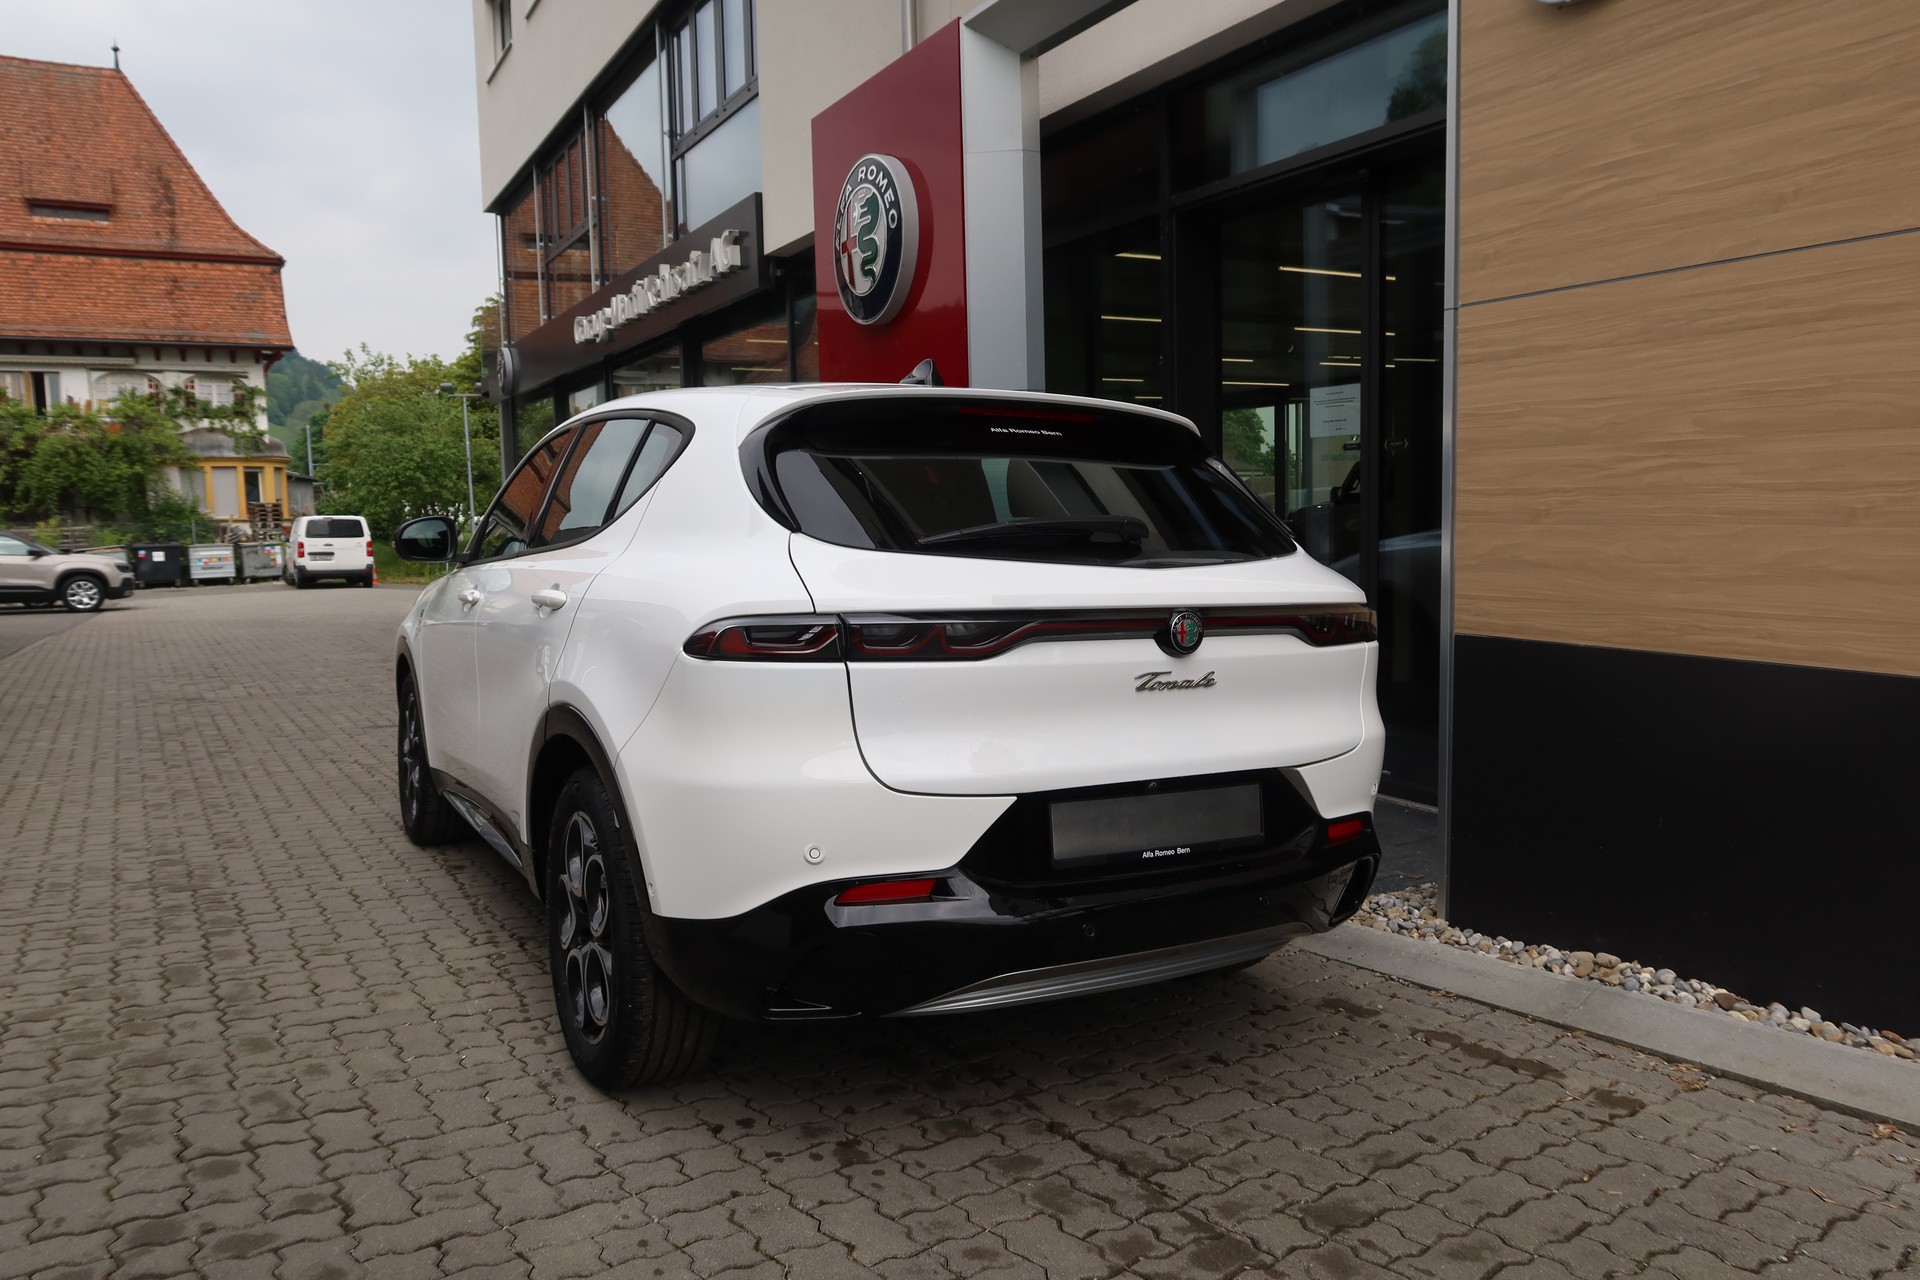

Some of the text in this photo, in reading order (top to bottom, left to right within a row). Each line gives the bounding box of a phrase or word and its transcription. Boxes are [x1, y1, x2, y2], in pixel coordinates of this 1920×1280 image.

[835, 165, 898, 251] ALFA ROMEO
[709, 229, 742, 275] AG
[1134, 671, 1217, 692] Tonale
